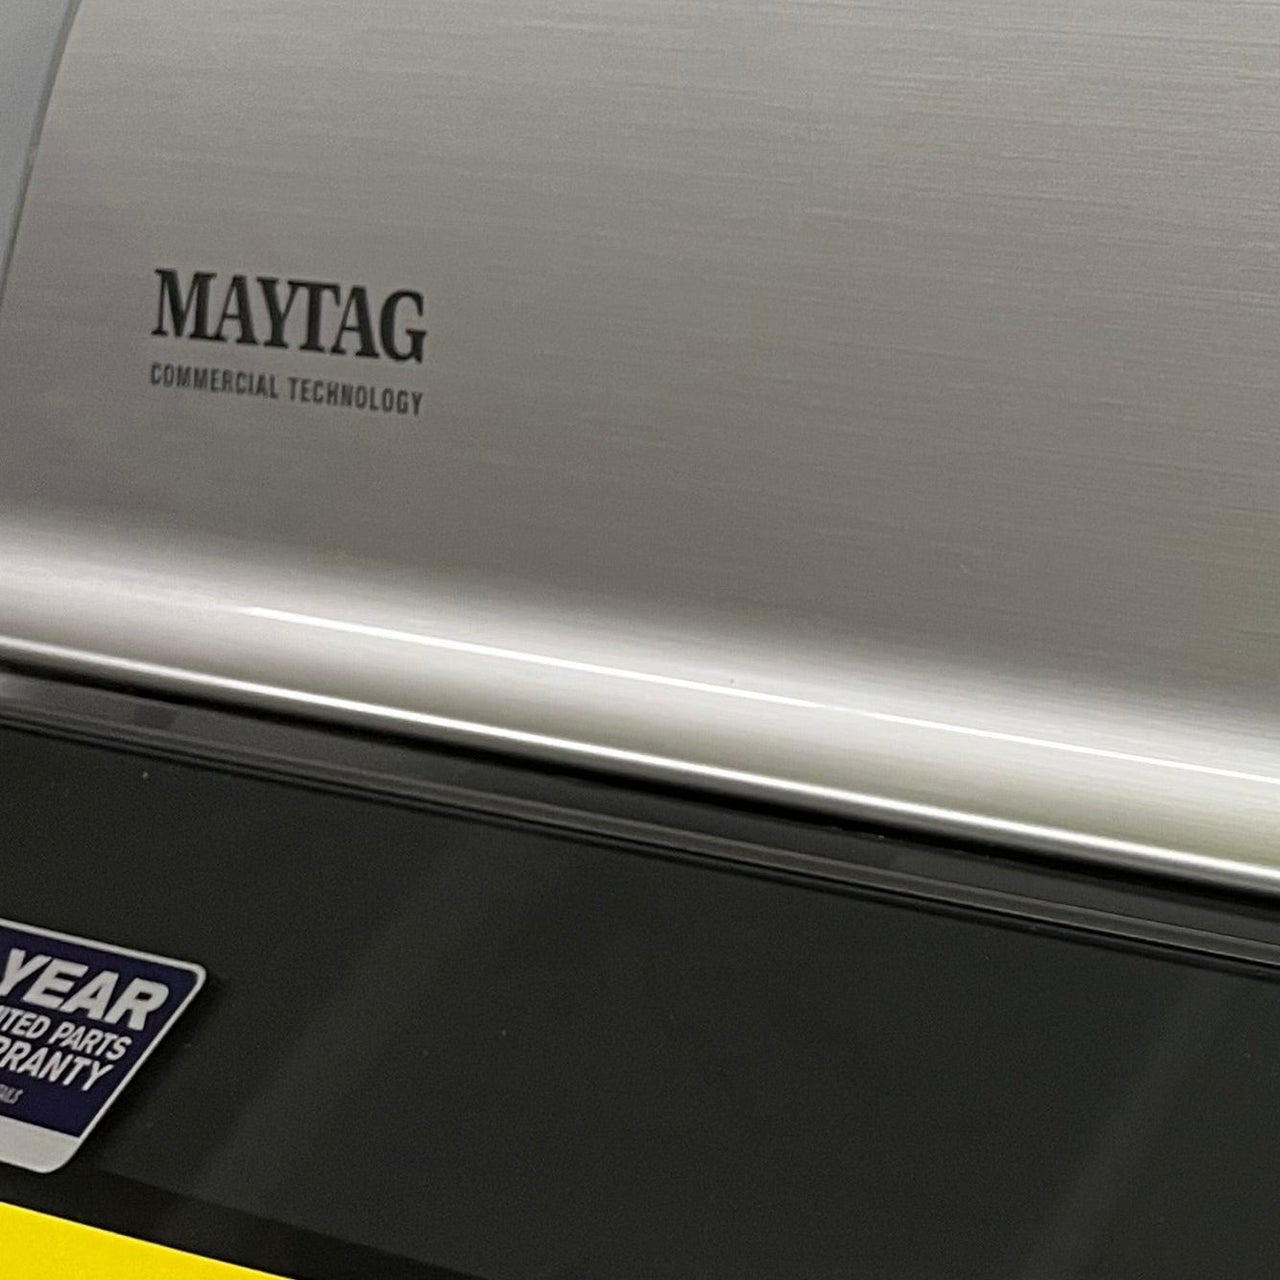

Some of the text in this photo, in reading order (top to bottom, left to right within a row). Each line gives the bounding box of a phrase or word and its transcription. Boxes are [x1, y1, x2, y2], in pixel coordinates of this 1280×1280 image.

[151, 267, 428, 365] MAYTAG
[150, 361, 424, 418] COMMERCIAL TECHNOLOGY
[0, 947, 170, 1031] YEAR
[48, 1020, 133, 1062] PARTS
